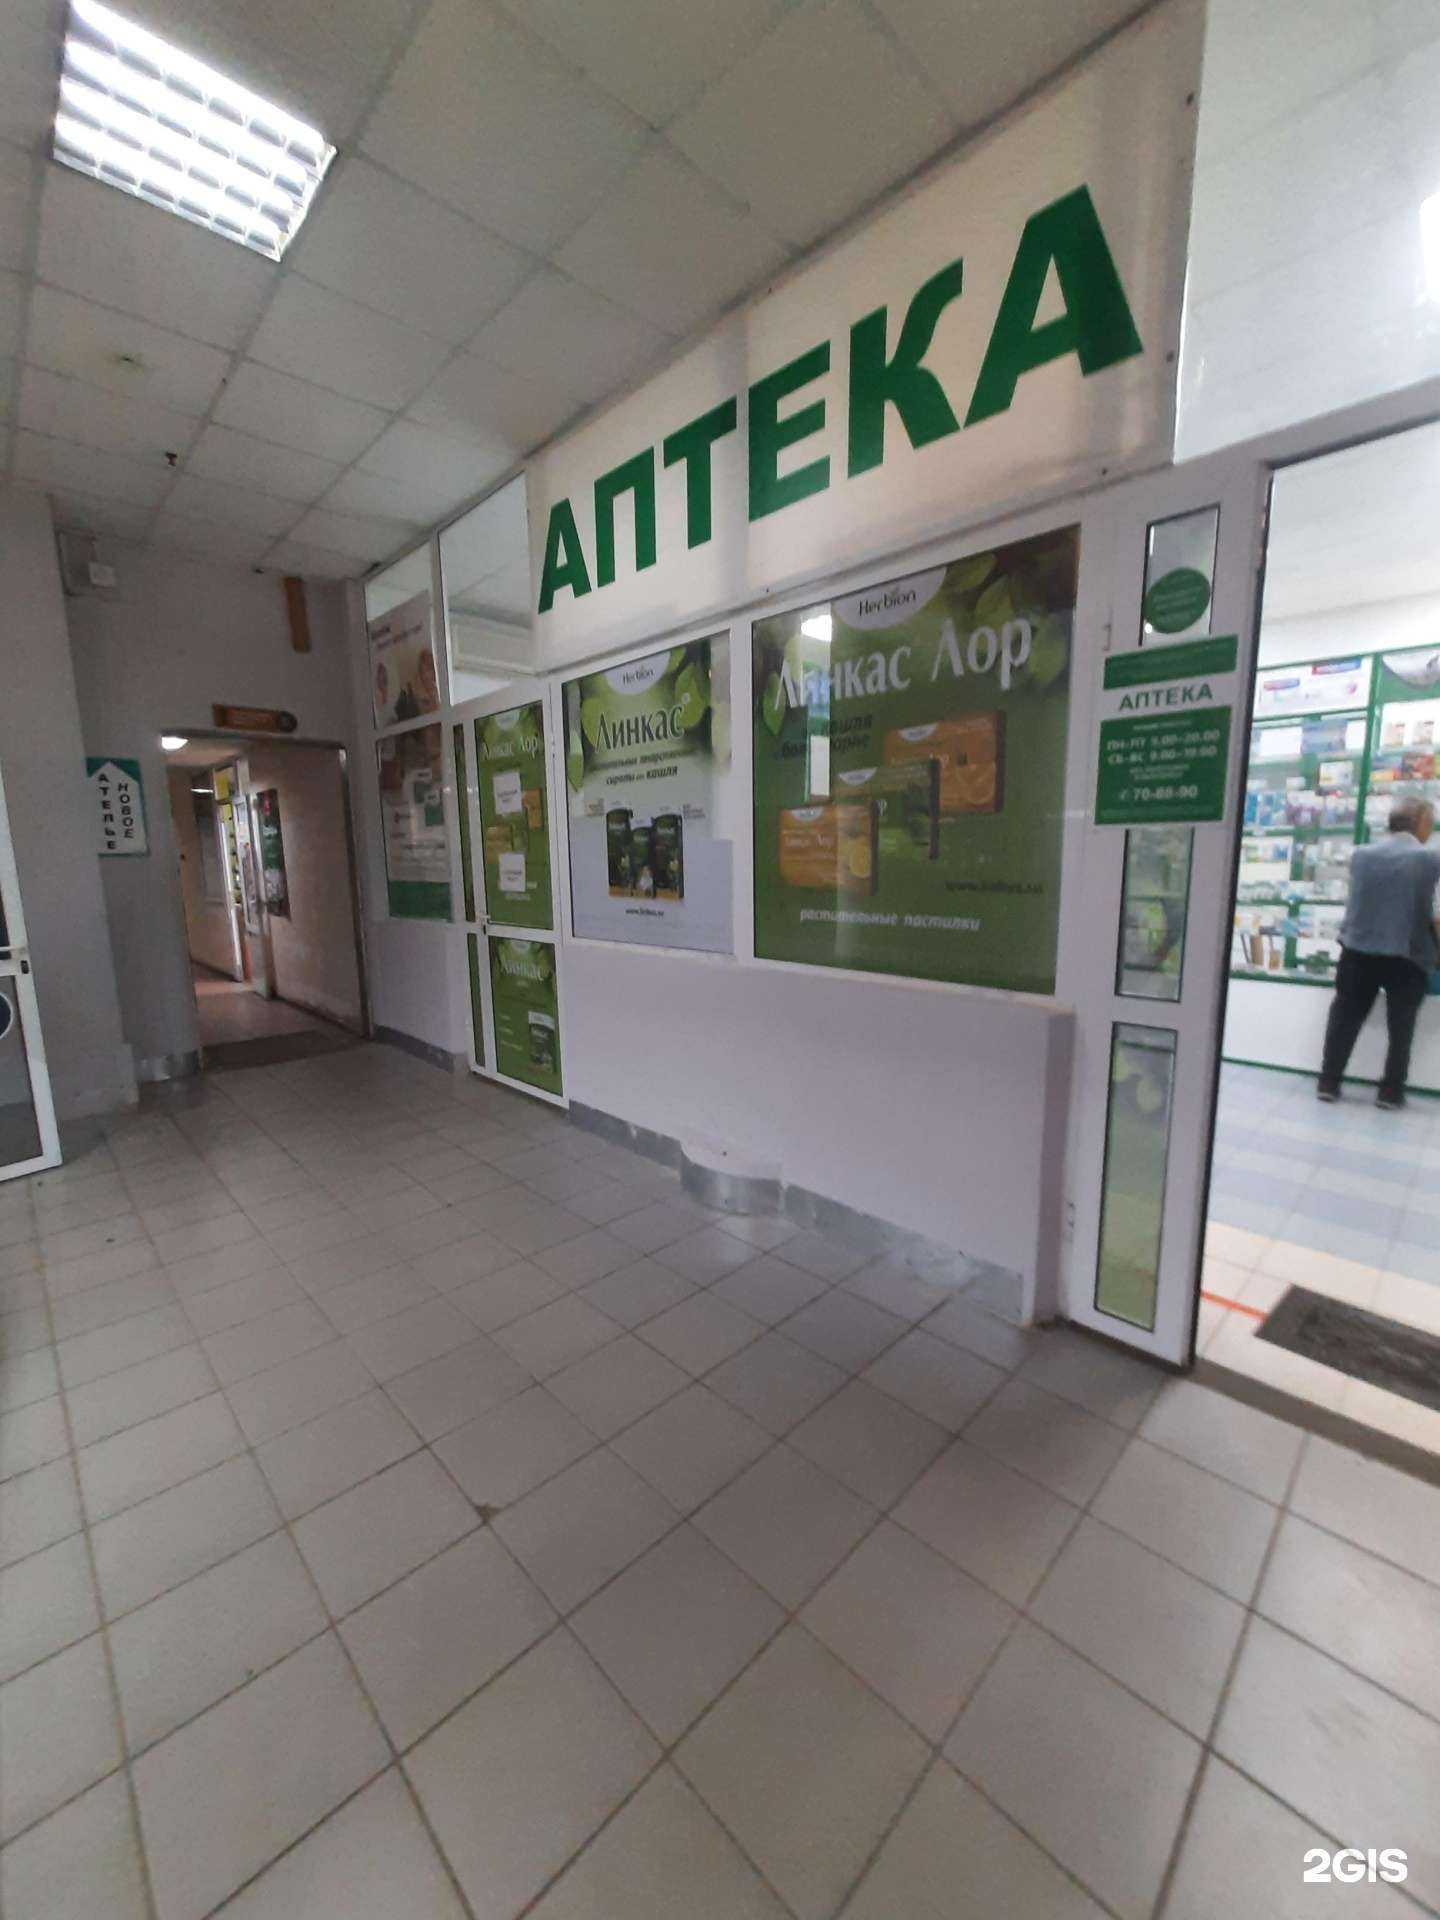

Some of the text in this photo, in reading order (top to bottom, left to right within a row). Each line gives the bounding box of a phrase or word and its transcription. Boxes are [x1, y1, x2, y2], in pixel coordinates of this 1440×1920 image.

[537, 184, 1142, 615] АПТЕКА
[859, 590, 917, 617] Herbion
[622, 668, 654, 684] Herbion
[931, 615, 1033, 690] Лор
[1118, 683, 1213, 711] АПТЕКА
[594, 705, 684, 752] Линкас
[98, 773, 117, 850] АТЕЛЬЕ
[117, 782, 135, 839] НОВОЕ
